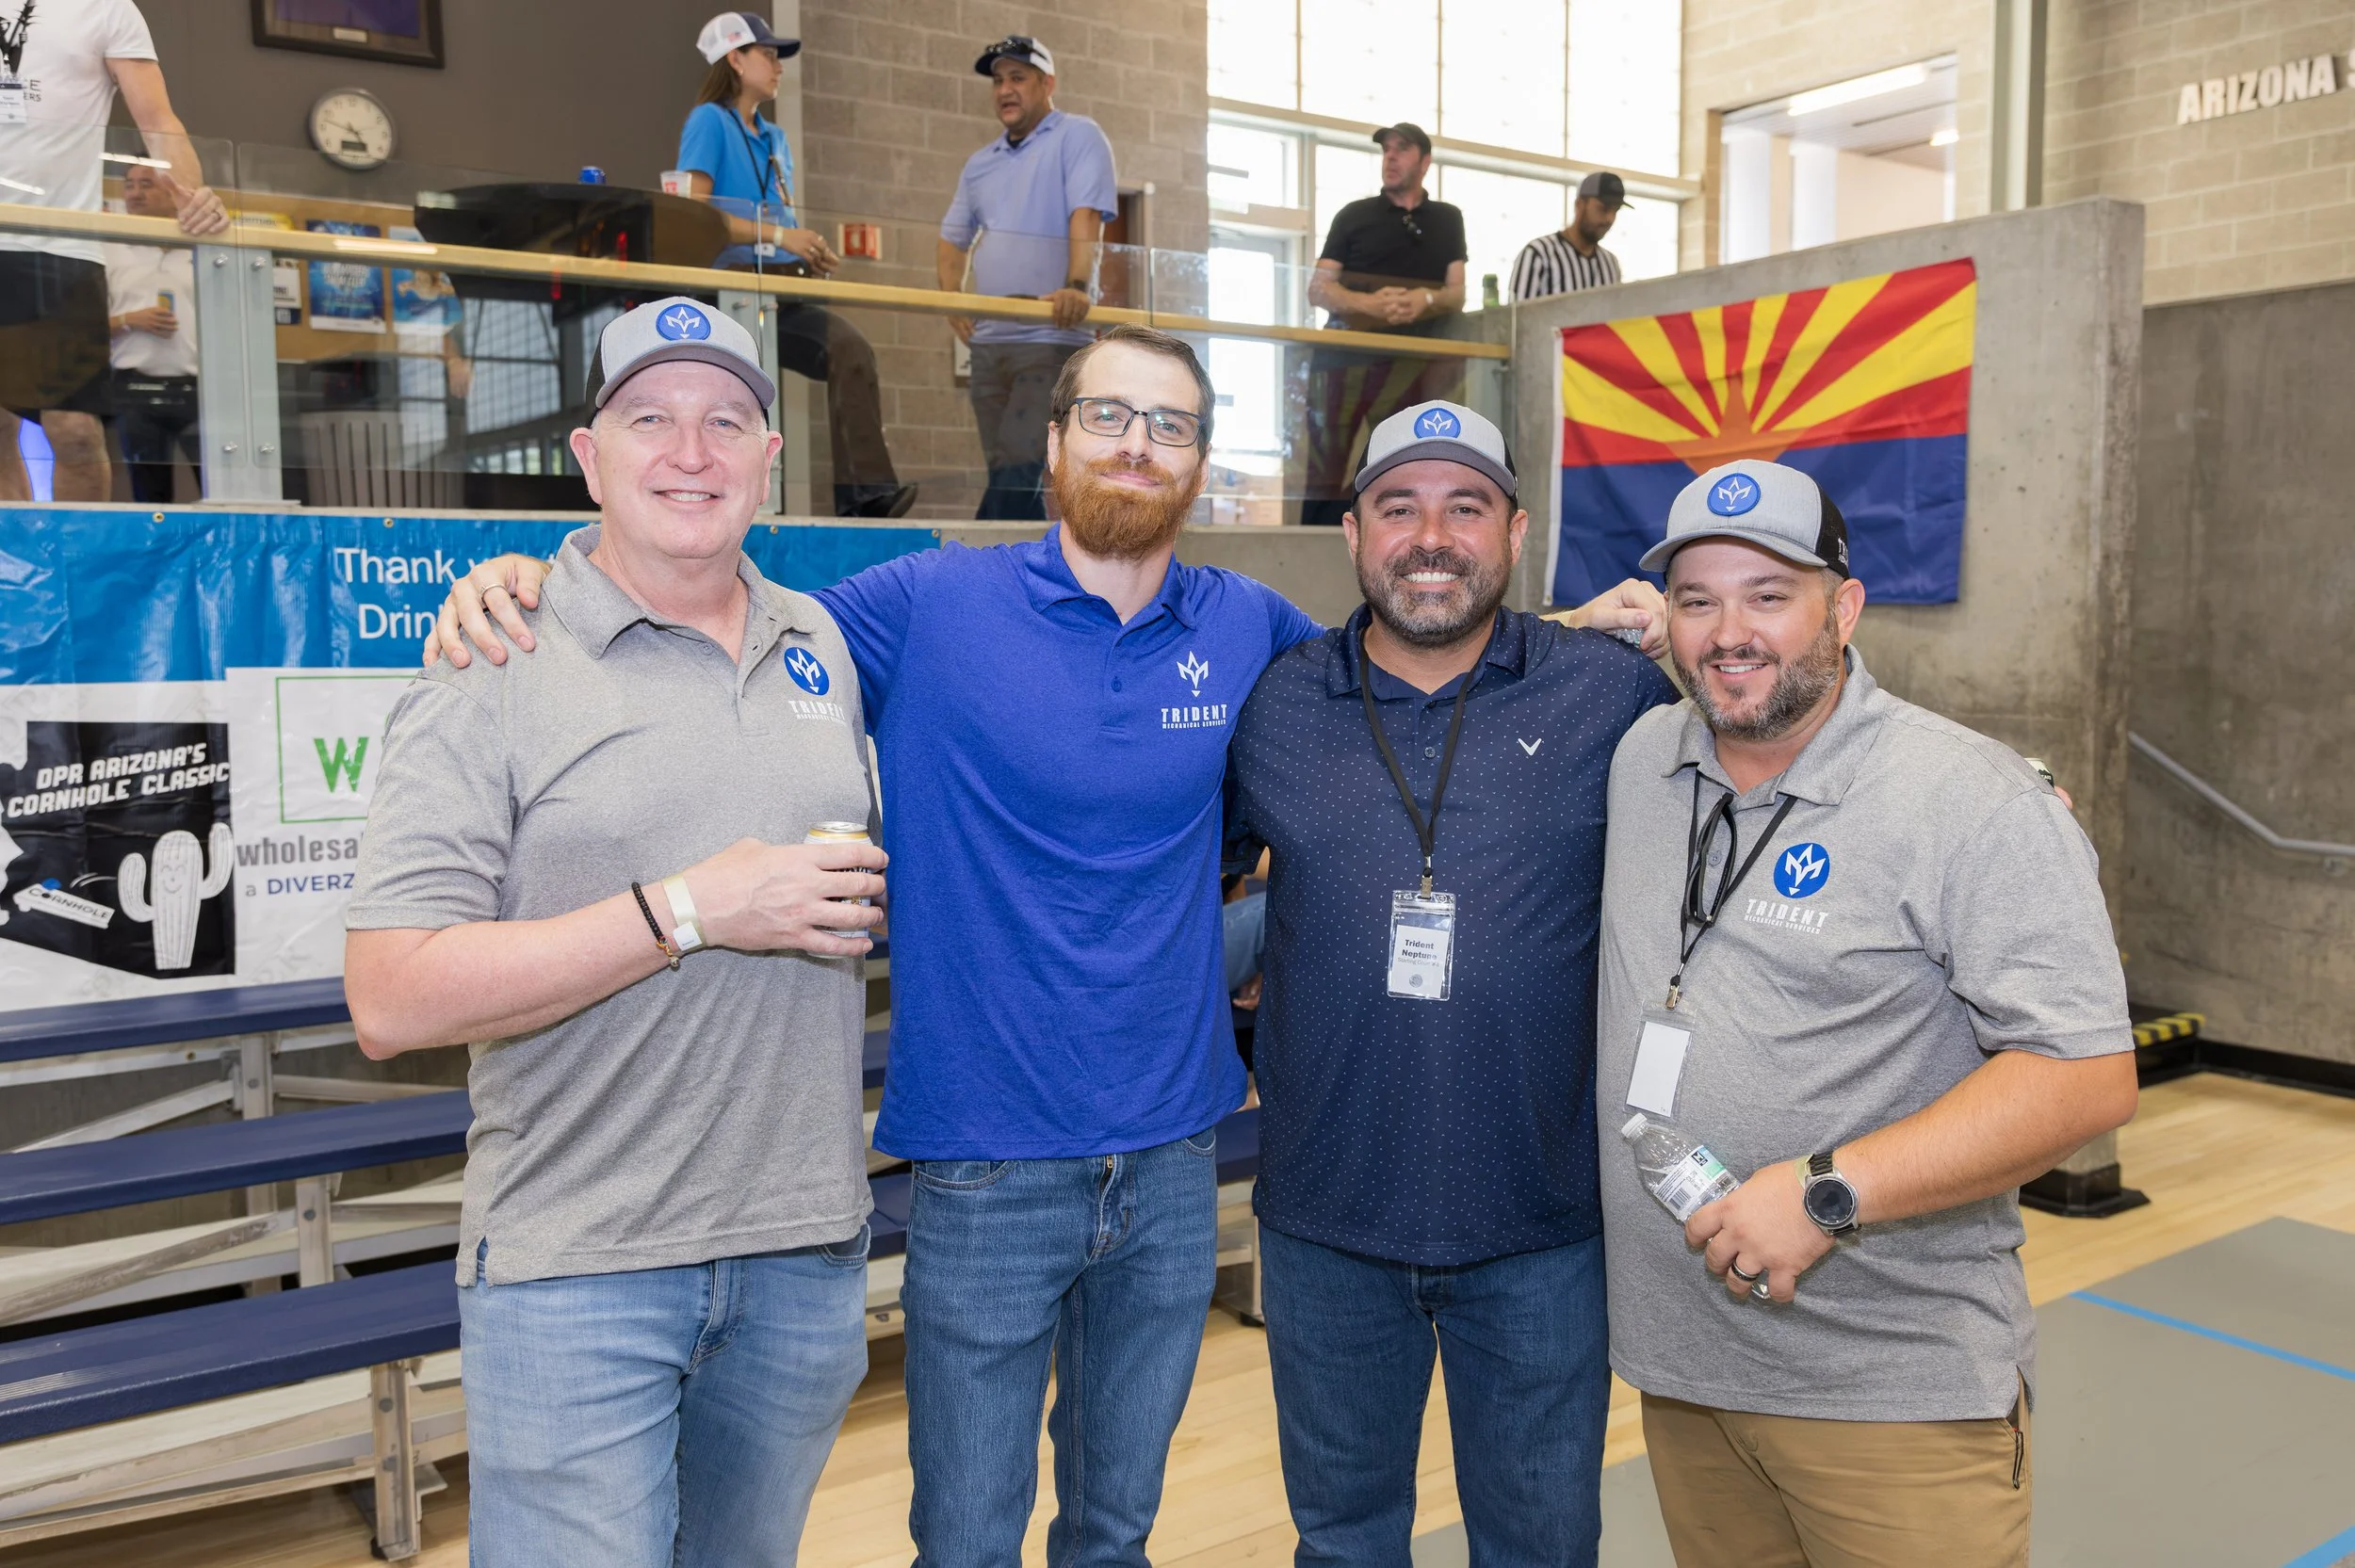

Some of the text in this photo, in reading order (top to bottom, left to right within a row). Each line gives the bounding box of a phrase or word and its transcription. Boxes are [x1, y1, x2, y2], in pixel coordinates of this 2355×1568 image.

[2177, 54, 2337, 125] ARIZONA
[334, 547, 457, 584] Thank
[358, 603, 445, 640] Drin
[1161, 703, 1227, 723] TRIDENT
[1202, 719, 1226, 727] SERVICES
[36, 742, 207, 790] DPR ARIZONA'S
[7, 762, 231, 818] CORNHOLE CLASSIC
[236, 832, 365, 867] wholesa
[245, 873, 356, 897] a DIVERZ
[1746, 898, 1828, 928] TRIDENT
[1402, 948, 1437, 960] Neptune
[1405, 939, 1435, 949] Trident
